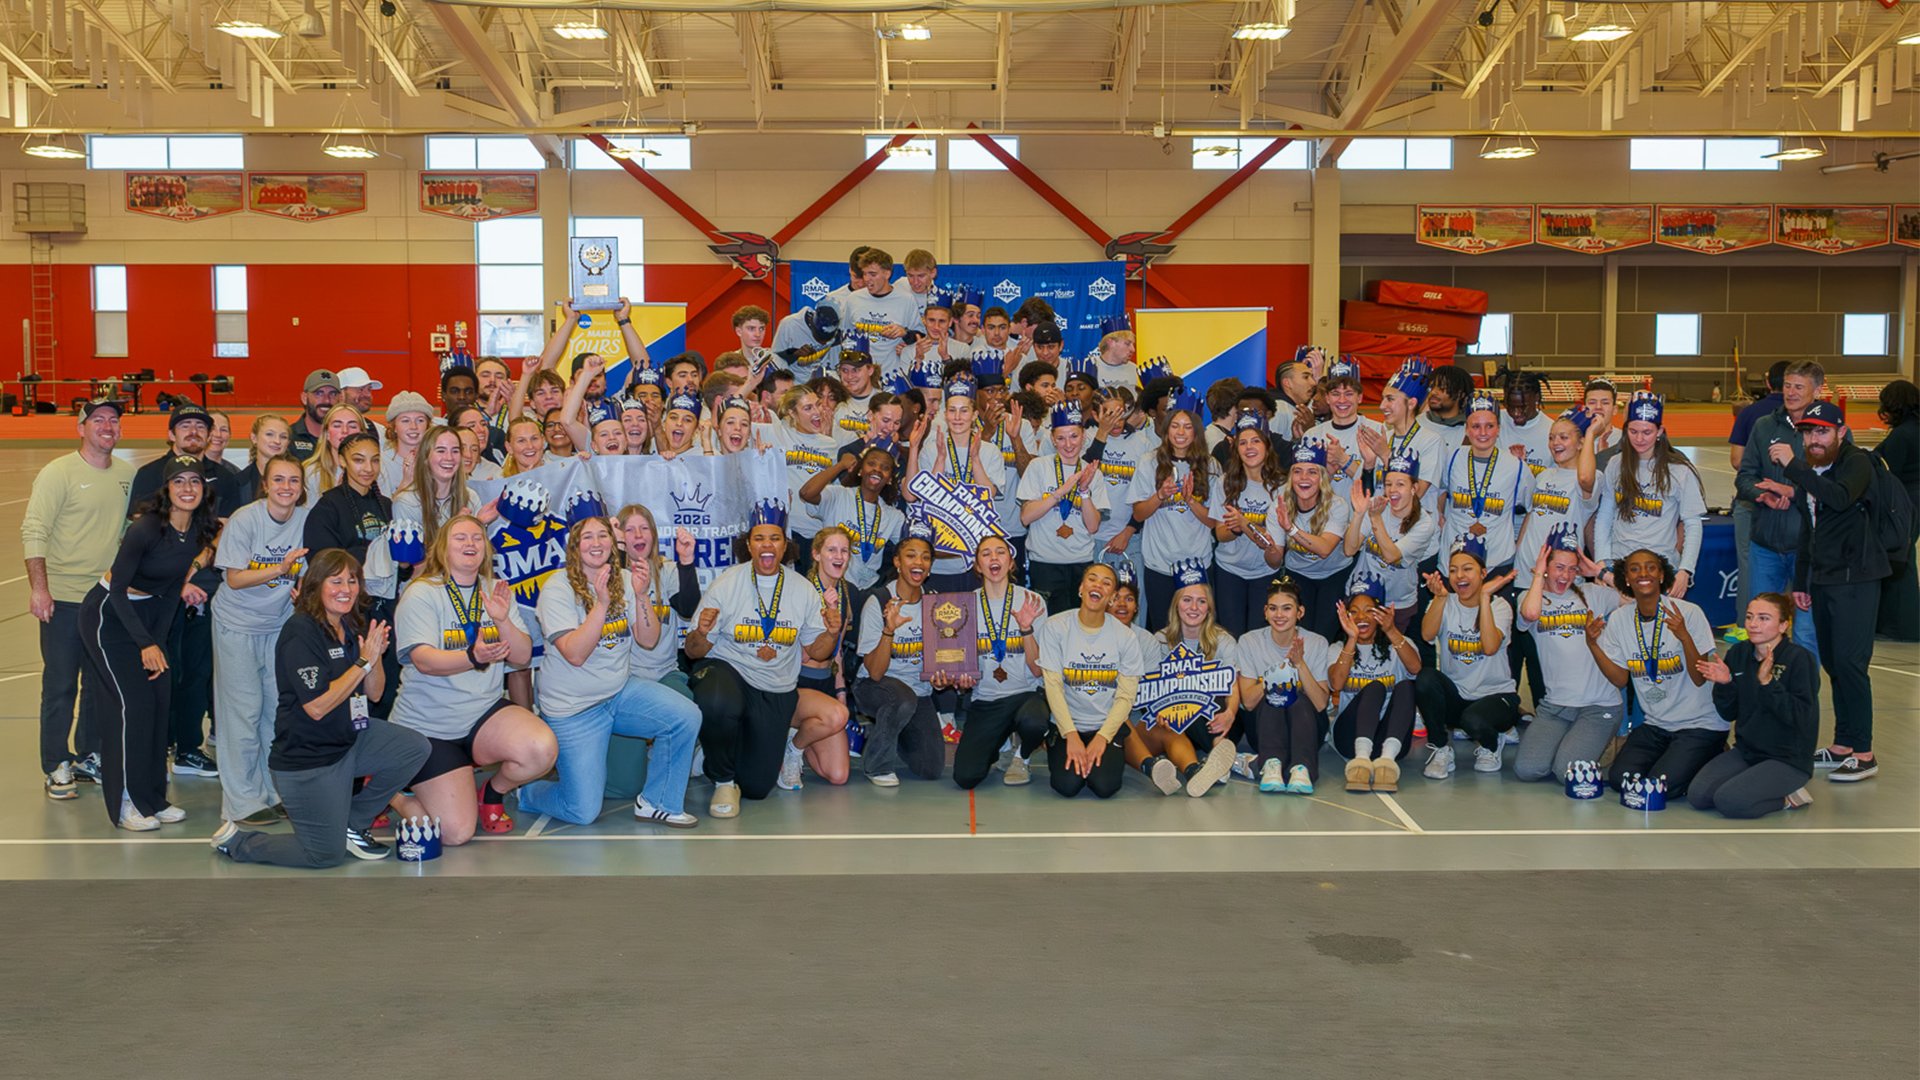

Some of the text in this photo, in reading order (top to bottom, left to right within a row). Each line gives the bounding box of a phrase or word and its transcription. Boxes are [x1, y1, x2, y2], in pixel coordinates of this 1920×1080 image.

[804, 285, 828, 294] RMAC
[995, 286, 1020, 296] RMAC
[1090, 284, 1115, 294] RMAC
[1423, 292, 1442, 300] GILL
[568, 332, 620, 359] YOURS
[952, 484, 996, 525] RMAC
[674, 514, 710, 525] 2026
[925, 506, 946, 518] INDOOR
[946, 516, 964, 533] TRACK
[702, 524, 740, 538] TRACK
[940, 524, 956, 540] 2026
[938, 609, 959, 617] RMAC
[1162, 658, 1201, 678] RMAC
[1152, 698, 1170, 710] INDOOR
